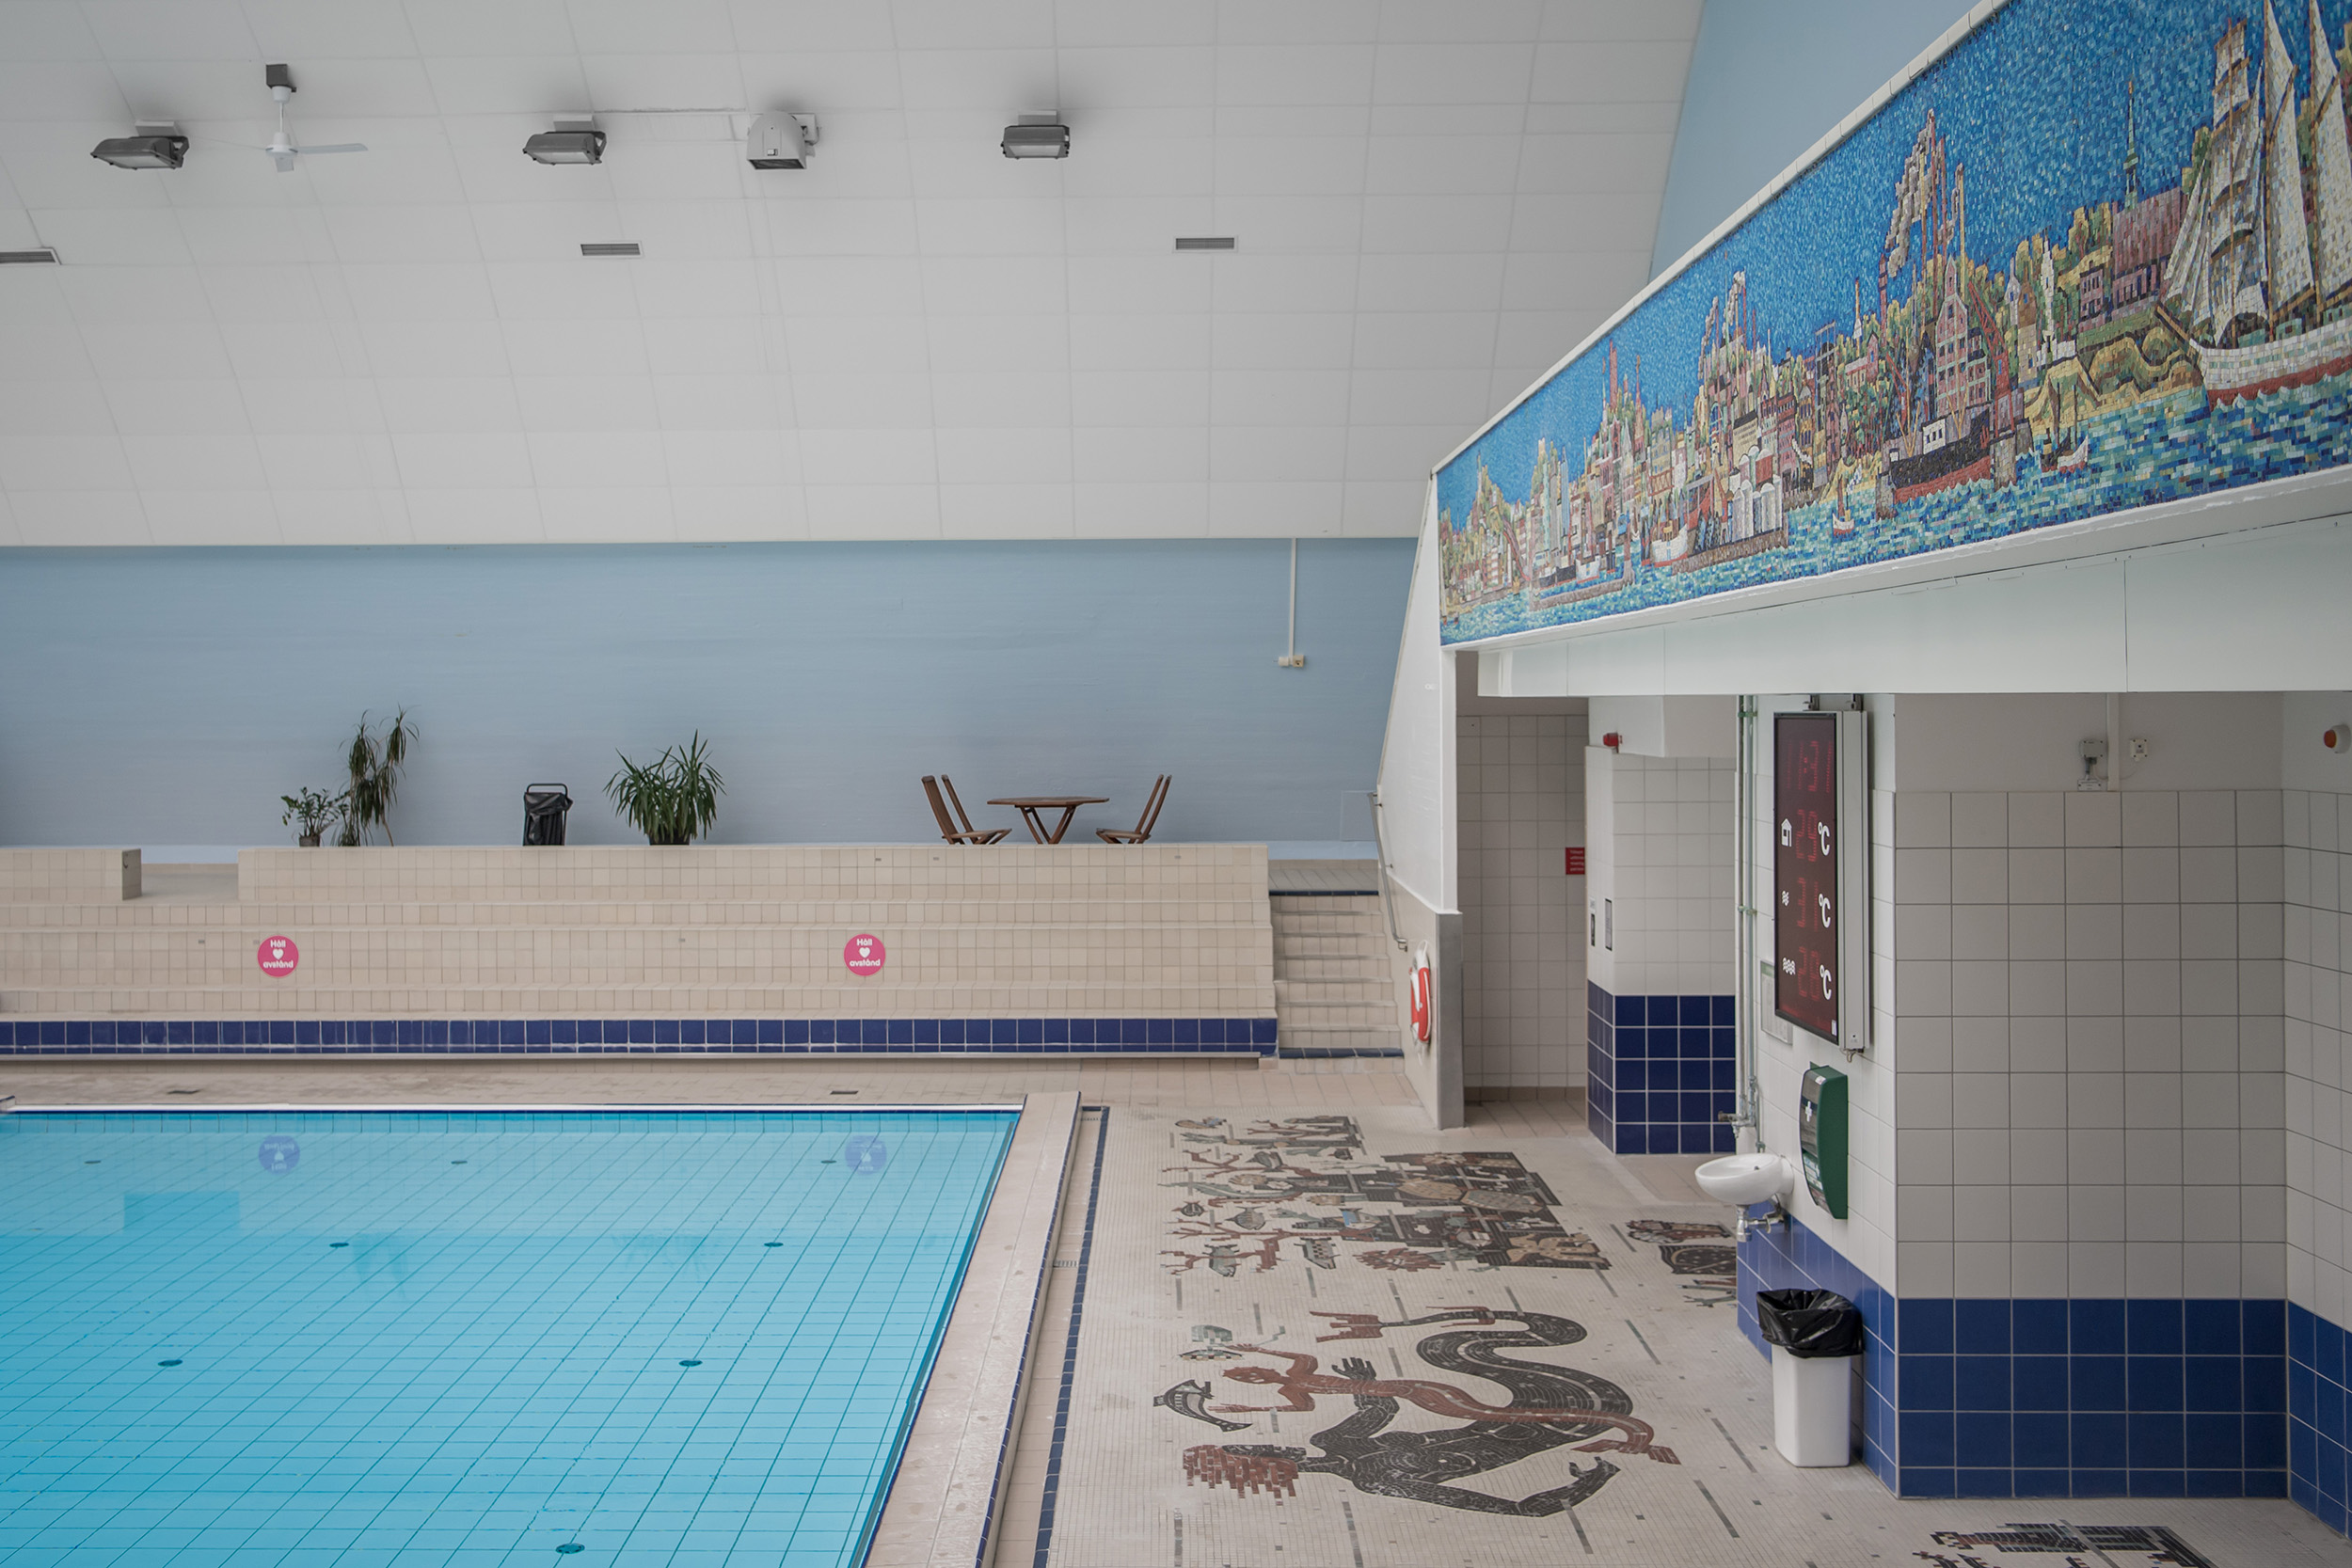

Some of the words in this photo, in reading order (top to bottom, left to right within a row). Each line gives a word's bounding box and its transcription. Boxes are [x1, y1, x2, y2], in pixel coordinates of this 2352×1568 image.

[270, 939, 286, 948] Håll
[856, 938, 873, 946] Håll
[262, 959, 294, 969] avstånd
[849, 958, 882, 967] avstånd
